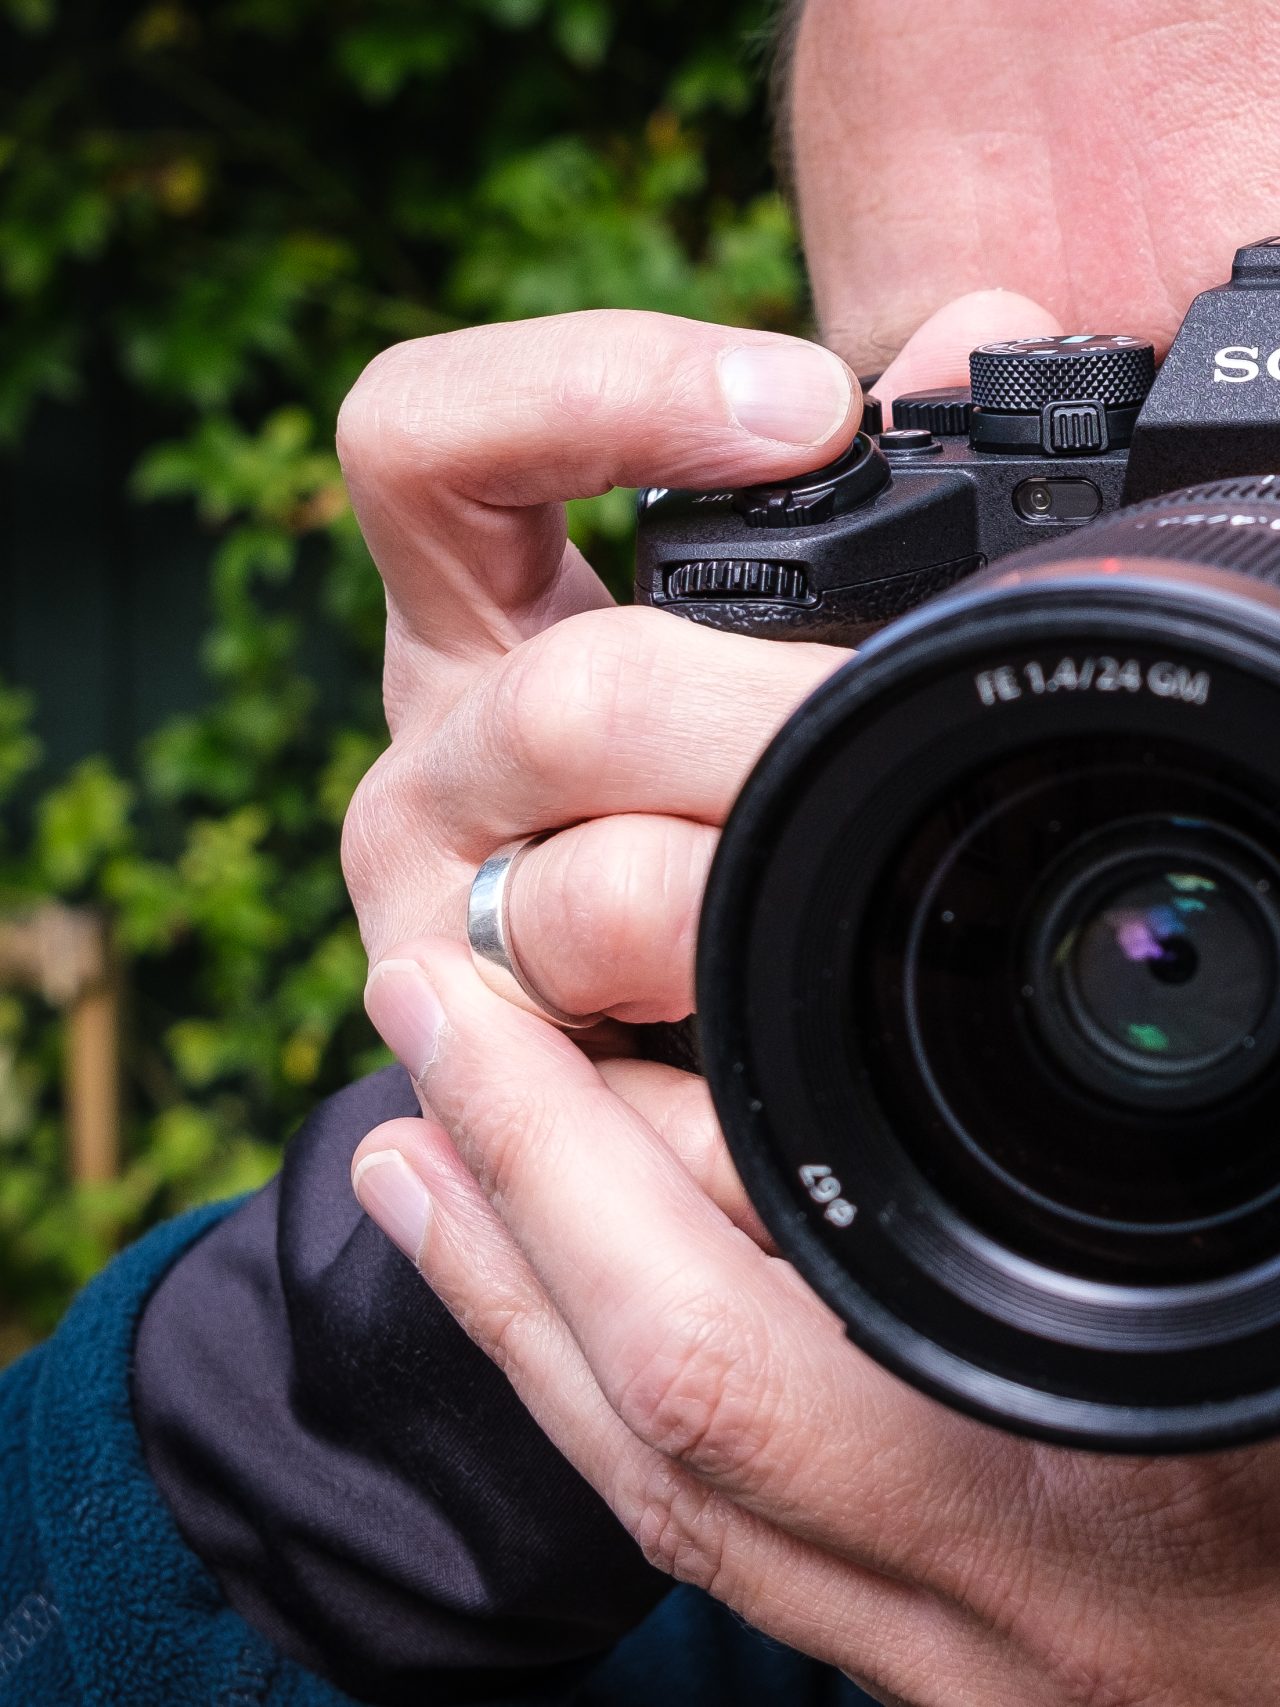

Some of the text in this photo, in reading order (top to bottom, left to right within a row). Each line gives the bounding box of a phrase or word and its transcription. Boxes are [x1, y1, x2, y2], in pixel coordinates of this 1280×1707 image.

[974, 656, 1211, 706] FE 1.4/24 GM
